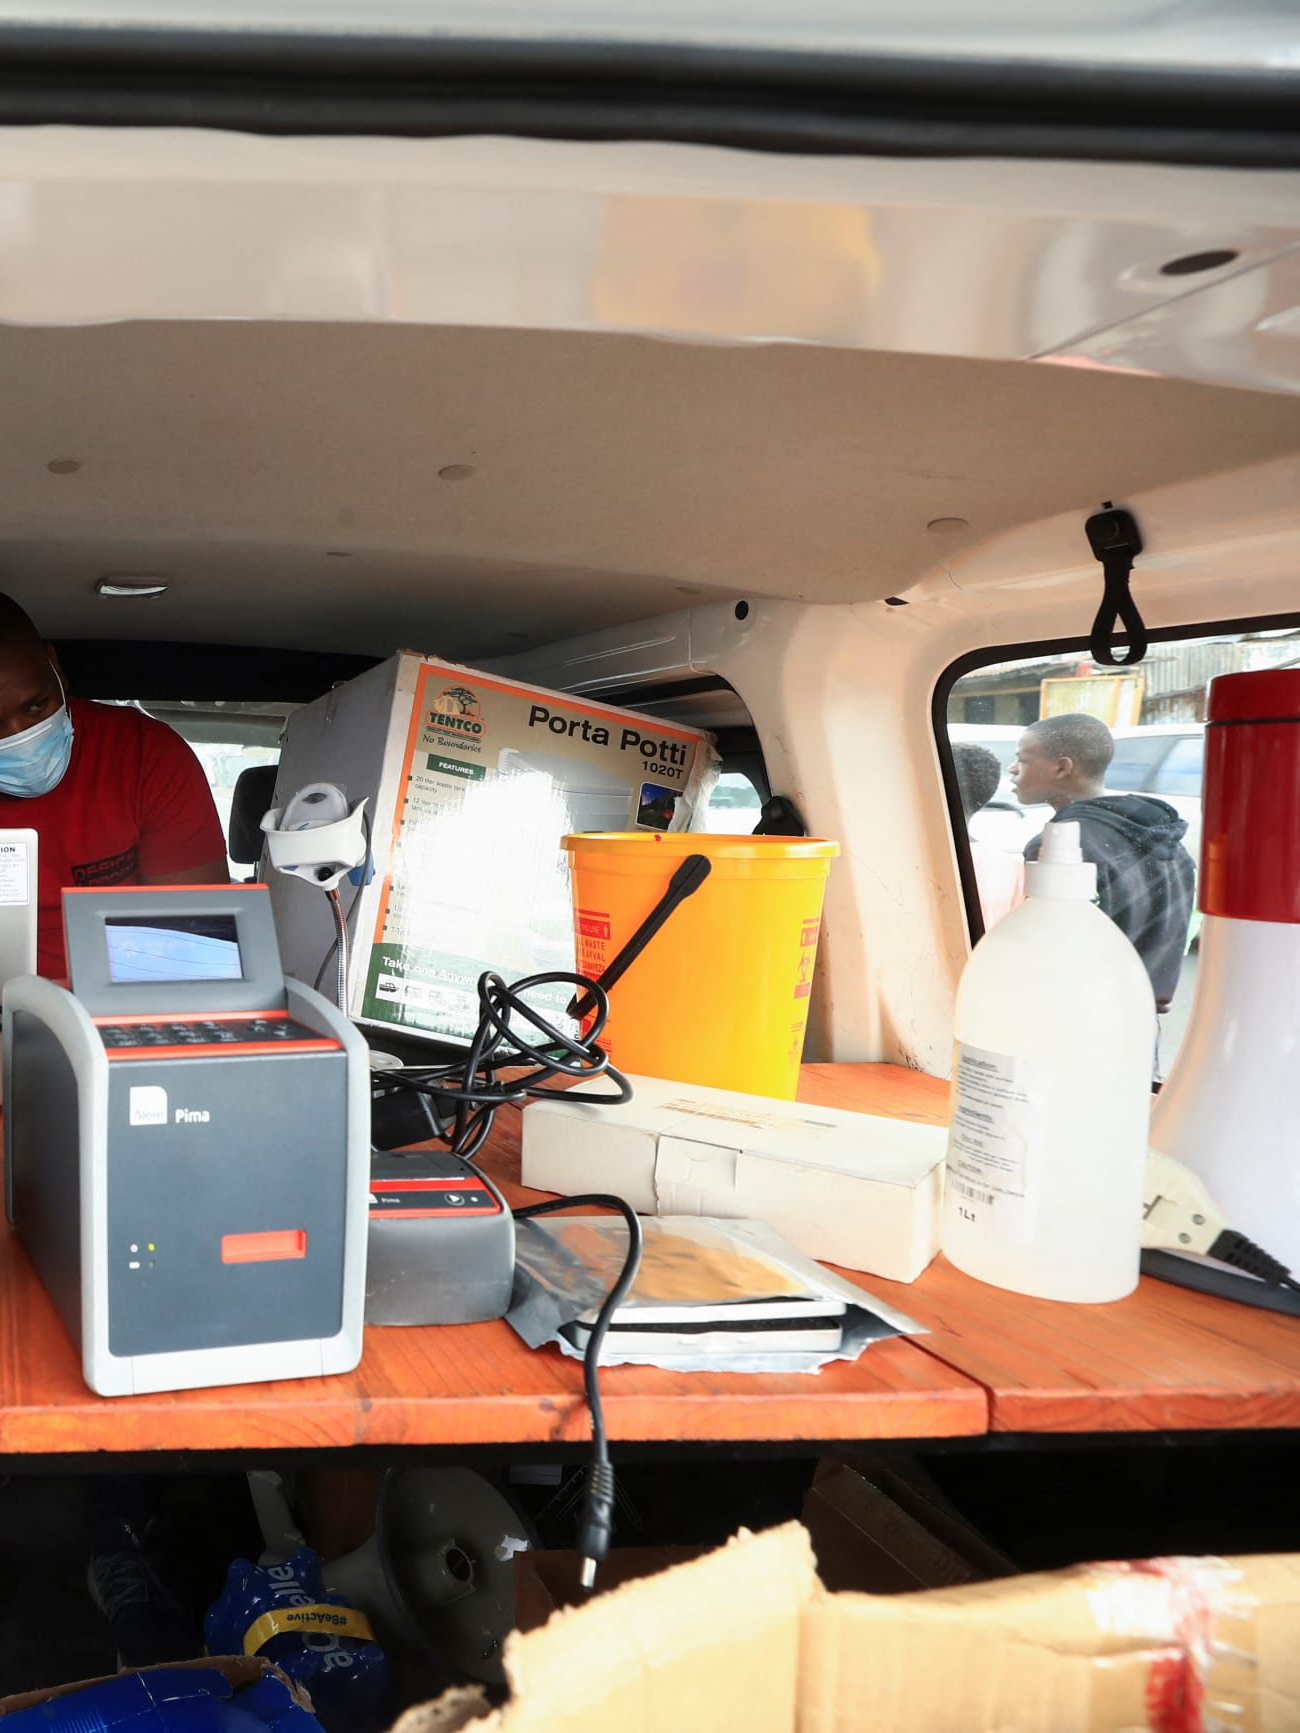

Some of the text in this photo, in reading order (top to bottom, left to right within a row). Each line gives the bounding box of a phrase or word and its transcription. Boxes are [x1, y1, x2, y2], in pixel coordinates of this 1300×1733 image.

[429, 711, 482, 734] TENTCO
[422, 734, 435, 744] No
[437, 737, 482, 753] Boundaries
[528, 705, 610, 746] Porta
[620, 728, 688, 766] Potti
[438, 762, 474, 775] FEATURES
[643, 761, 684, 779] 1020T
[383, 956, 410, 972] Take
[175, 1108, 210, 1123] Pima
[287, 1613, 348, 1626] #BeActive
